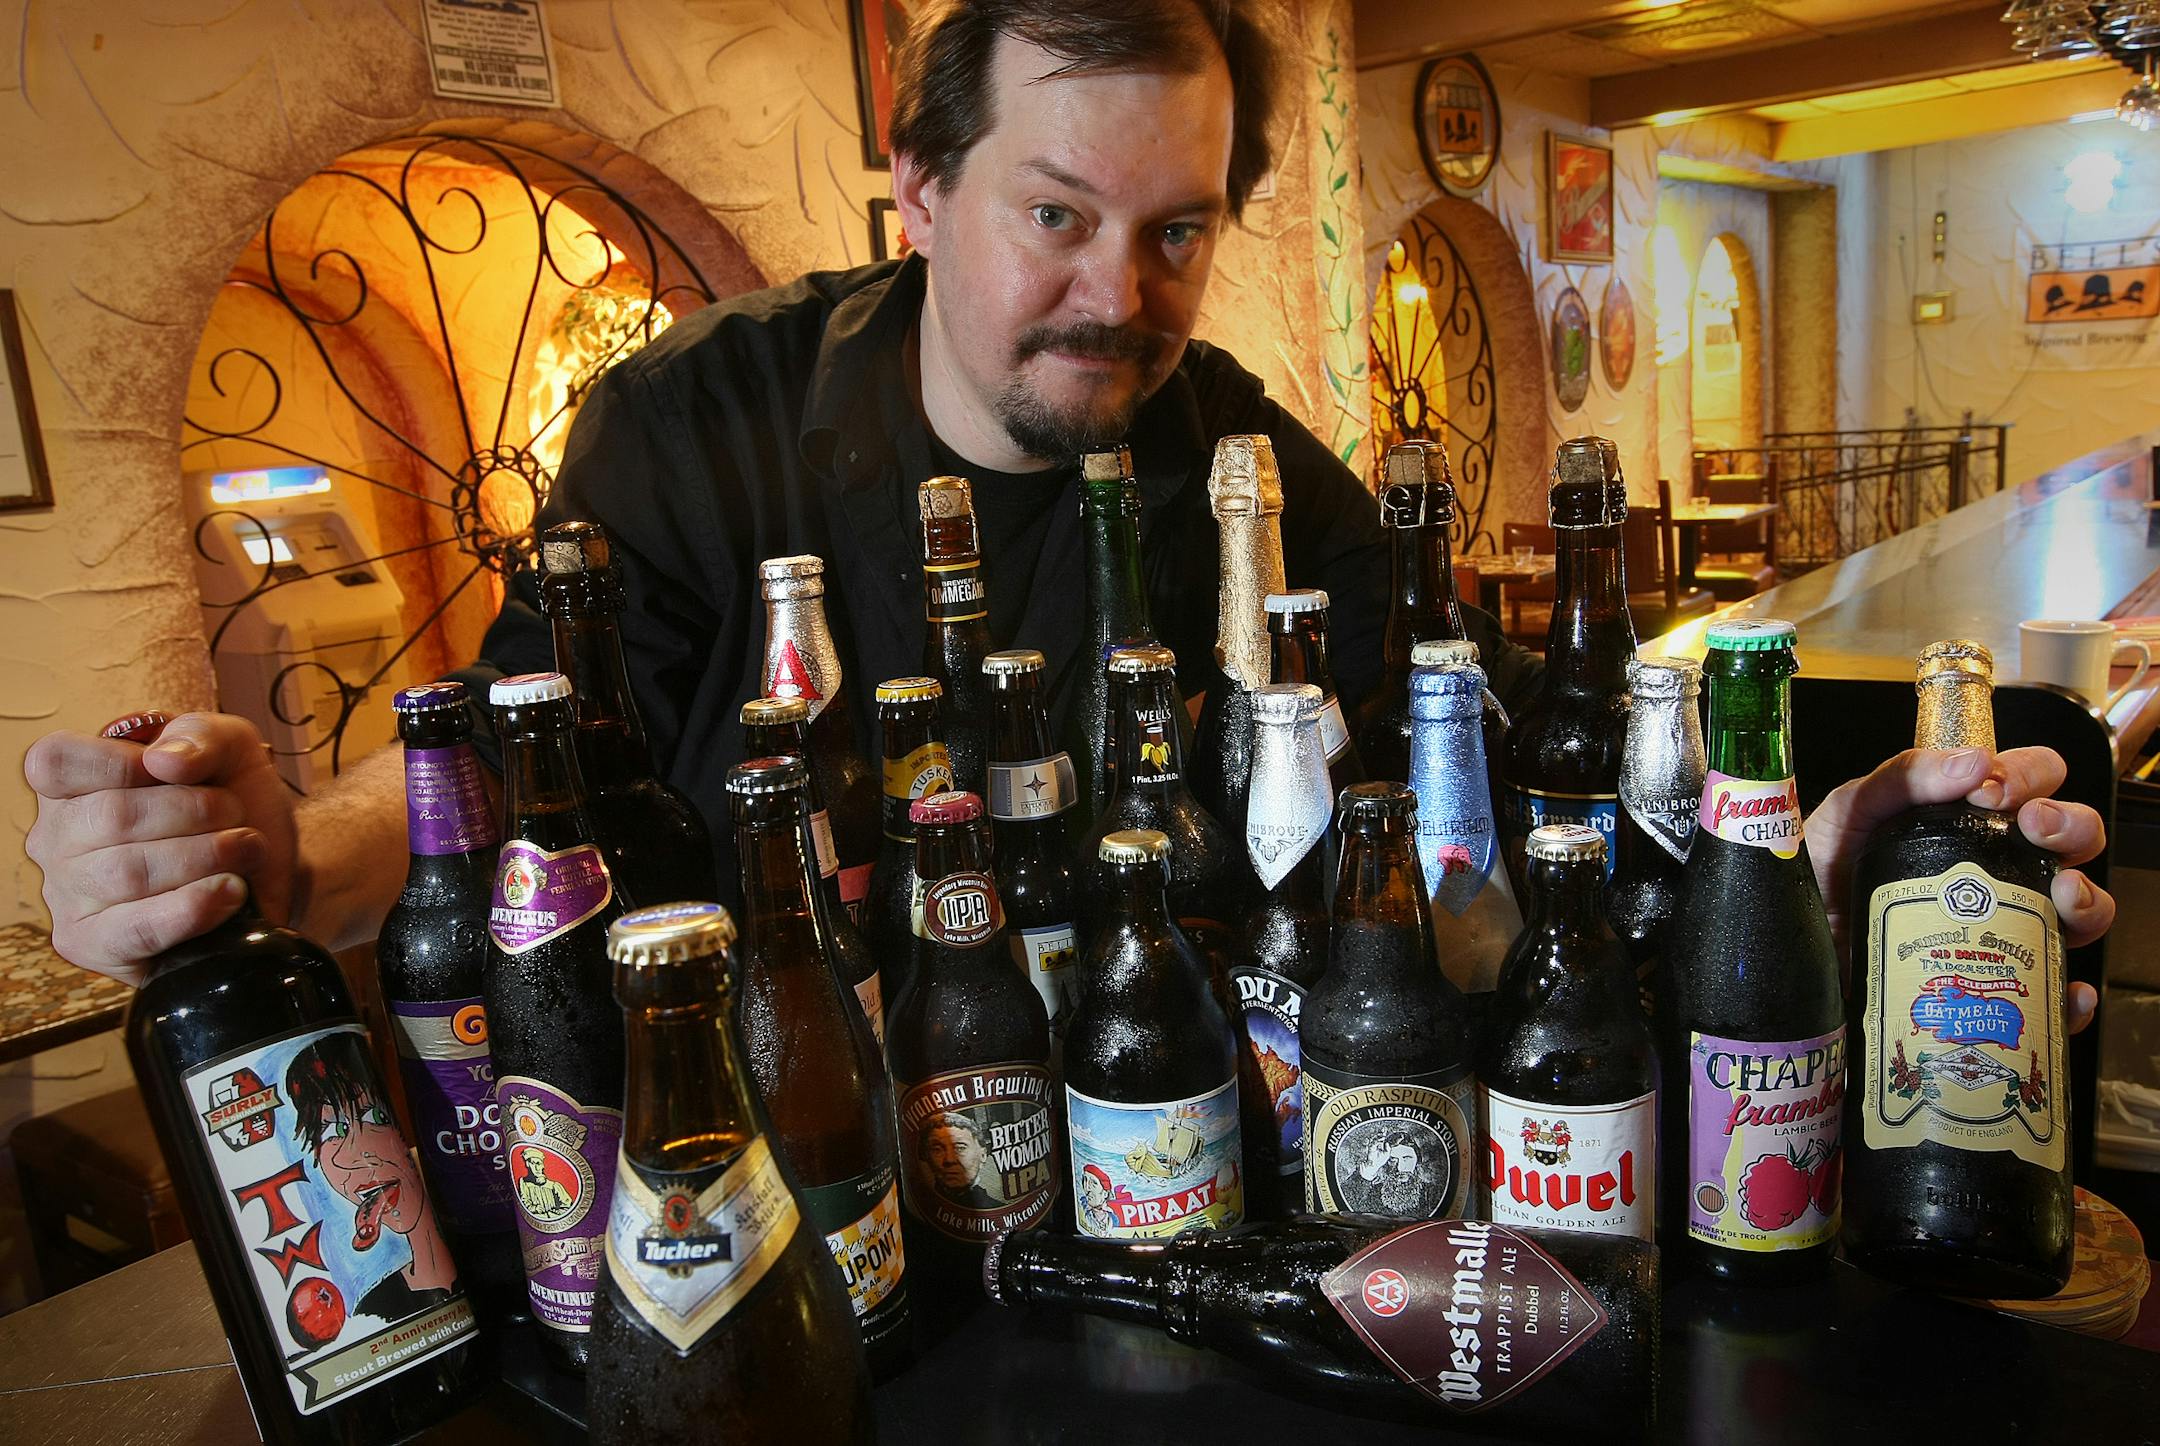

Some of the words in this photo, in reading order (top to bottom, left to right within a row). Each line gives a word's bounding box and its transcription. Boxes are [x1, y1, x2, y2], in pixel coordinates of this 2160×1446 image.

[1135, 708, 1172, 722] WELLS
[941, 892, 990, 930] IPA
[2011, 891, 2027, 903] 550
[1919, 957, 2017, 978] TADCASTER
[1930, 949, 1951, 960] OLD
[1955, 949, 2008, 965] BREWERY
[1236, 976, 1279, 1003] DU
[1957, 978, 2017, 990] CELEBRATED
[1247, 1000, 1298, 1034] FERMENTATION
[1924, 1001, 2004, 1020] OATMEAL
[1953, 1019, 2009, 1037] STOUT
[971, 1075, 1043, 1100] Brewing
[210, 1090, 272, 1124] SURLY
[1330, 1094, 1360, 1117] OLD
[1366, 1088, 1452, 1117] RASPUTIN
[989, 1107, 1050, 1151] BITTER
[1327, 1111, 1364, 1154] RUSSIAN
[1367, 1106, 1430, 1124] IMPERIAL
[1433, 1119, 1458, 1156] STOUT
[1774, 1122, 1817, 1136] LAMBIC
[1928, 1116, 1964, 1137] PRODUCT
[1966, 1128, 1977, 1138] OF
[1978, 1124, 2014, 1139] ENGLAND
[991, 1130, 1052, 1174] WOMAN
[1579, 1139, 1602, 1148] 1871
[1007, 1160, 1051, 1197] IPA
[936, 1207, 963, 1231] Lake
[1002, 1189, 1050, 1229] Wisconsin
[1120, 1183, 1213, 1226] PIRAAT
[1491, 1202, 1530, 1221] LGIAN
[1535, 1215, 1596, 1228] GOLDEN
[1602, 1215, 1627, 1226] ALE
[1691, 1220, 1726, 1237] BREWERY
[1727, 1231, 1737, 1239] DE
[1739, 1232, 1767, 1241] TROCH
[645, 1241, 719, 1261] Tucher
[841, 1224, 896, 1288] UPONT
[1501, 1246, 1517, 1275] ALE
[1437, 1220, 1492, 1402] Westmalle
[1524, 1284, 1541, 1335] Dubbel
[392, 1309, 457, 1346] Anniversary
[1497, 1283, 1513, 1373] TRAPPIST
[1559, 1316, 1569, 1335] 11.2
[334, 1361, 375, 1387] Stout
[376, 1336, 428, 1368] Brewed
[428, 1325, 453, 1344] with
